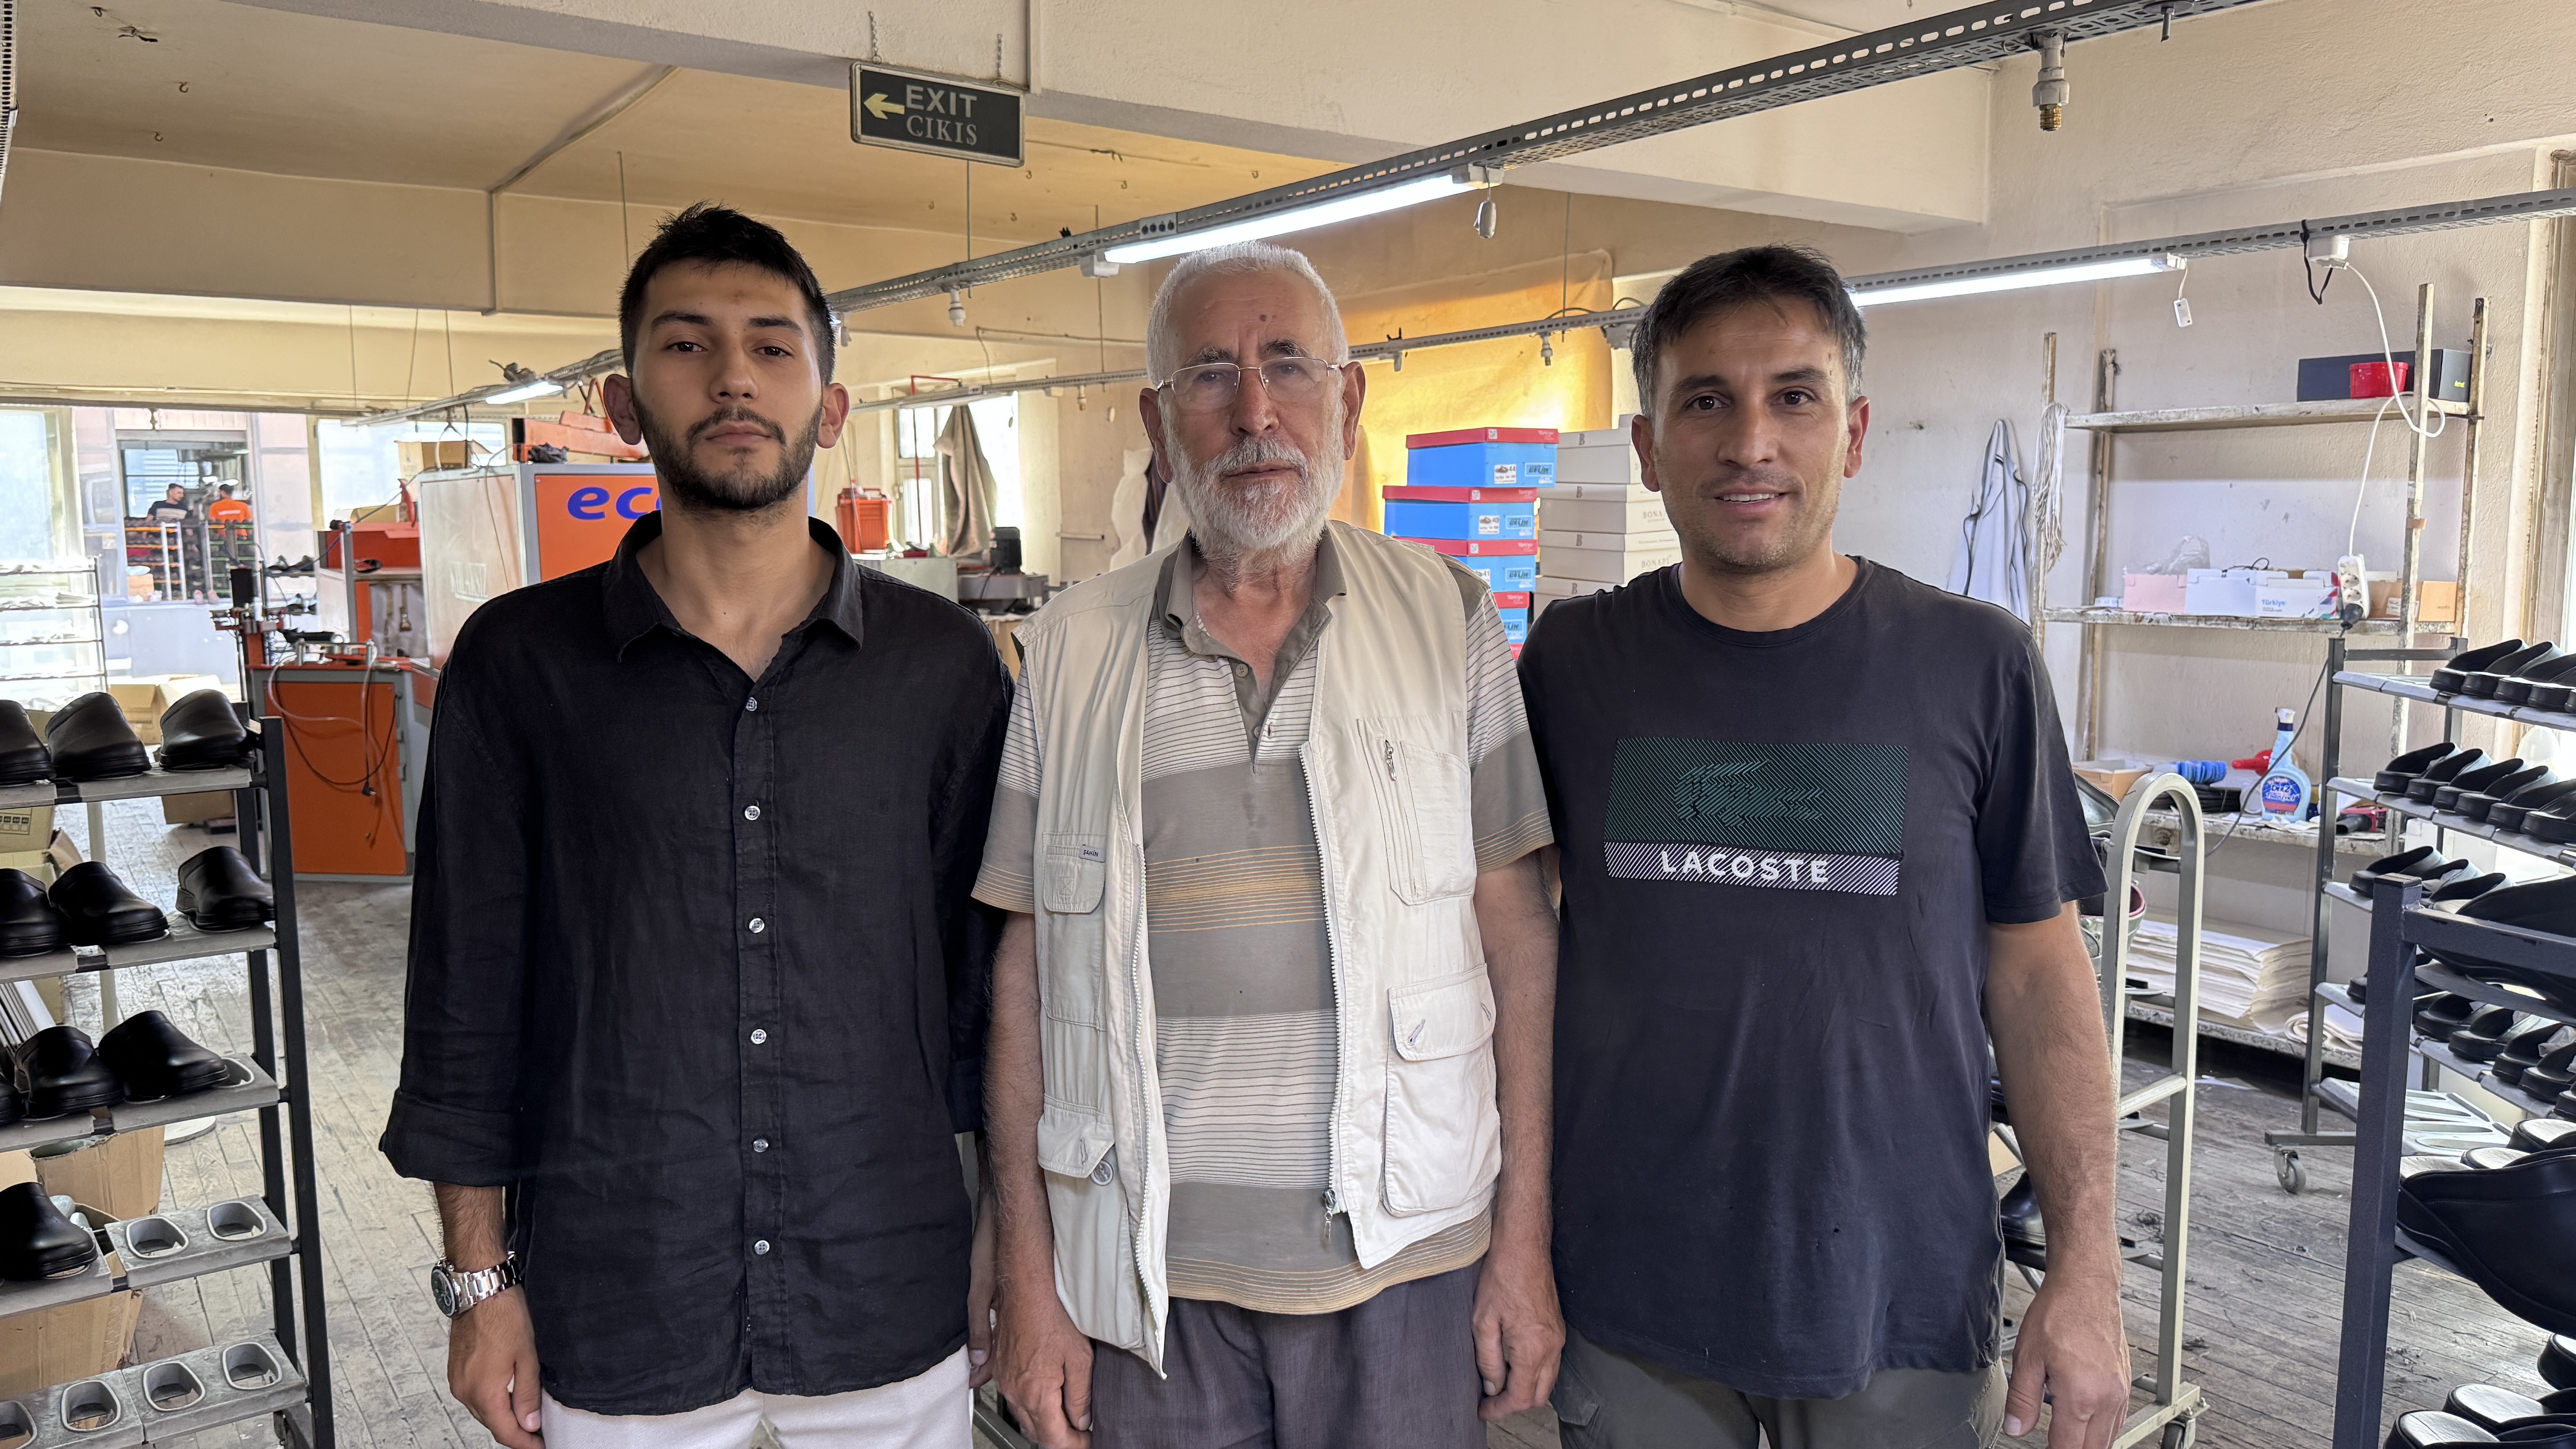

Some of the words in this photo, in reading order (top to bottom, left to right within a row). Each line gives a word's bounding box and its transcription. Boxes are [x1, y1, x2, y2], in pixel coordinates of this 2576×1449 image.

[906, 84, 977, 118] EXIT
[1578, 433, 1585, 446] B
[1576, 486, 1582, 498] B
[567, 487, 661, 520] ec
[1576, 534, 1582, 546] B
[1572, 583, 1578, 594] B
[1662, 851, 1828, 883] LACOSTE
